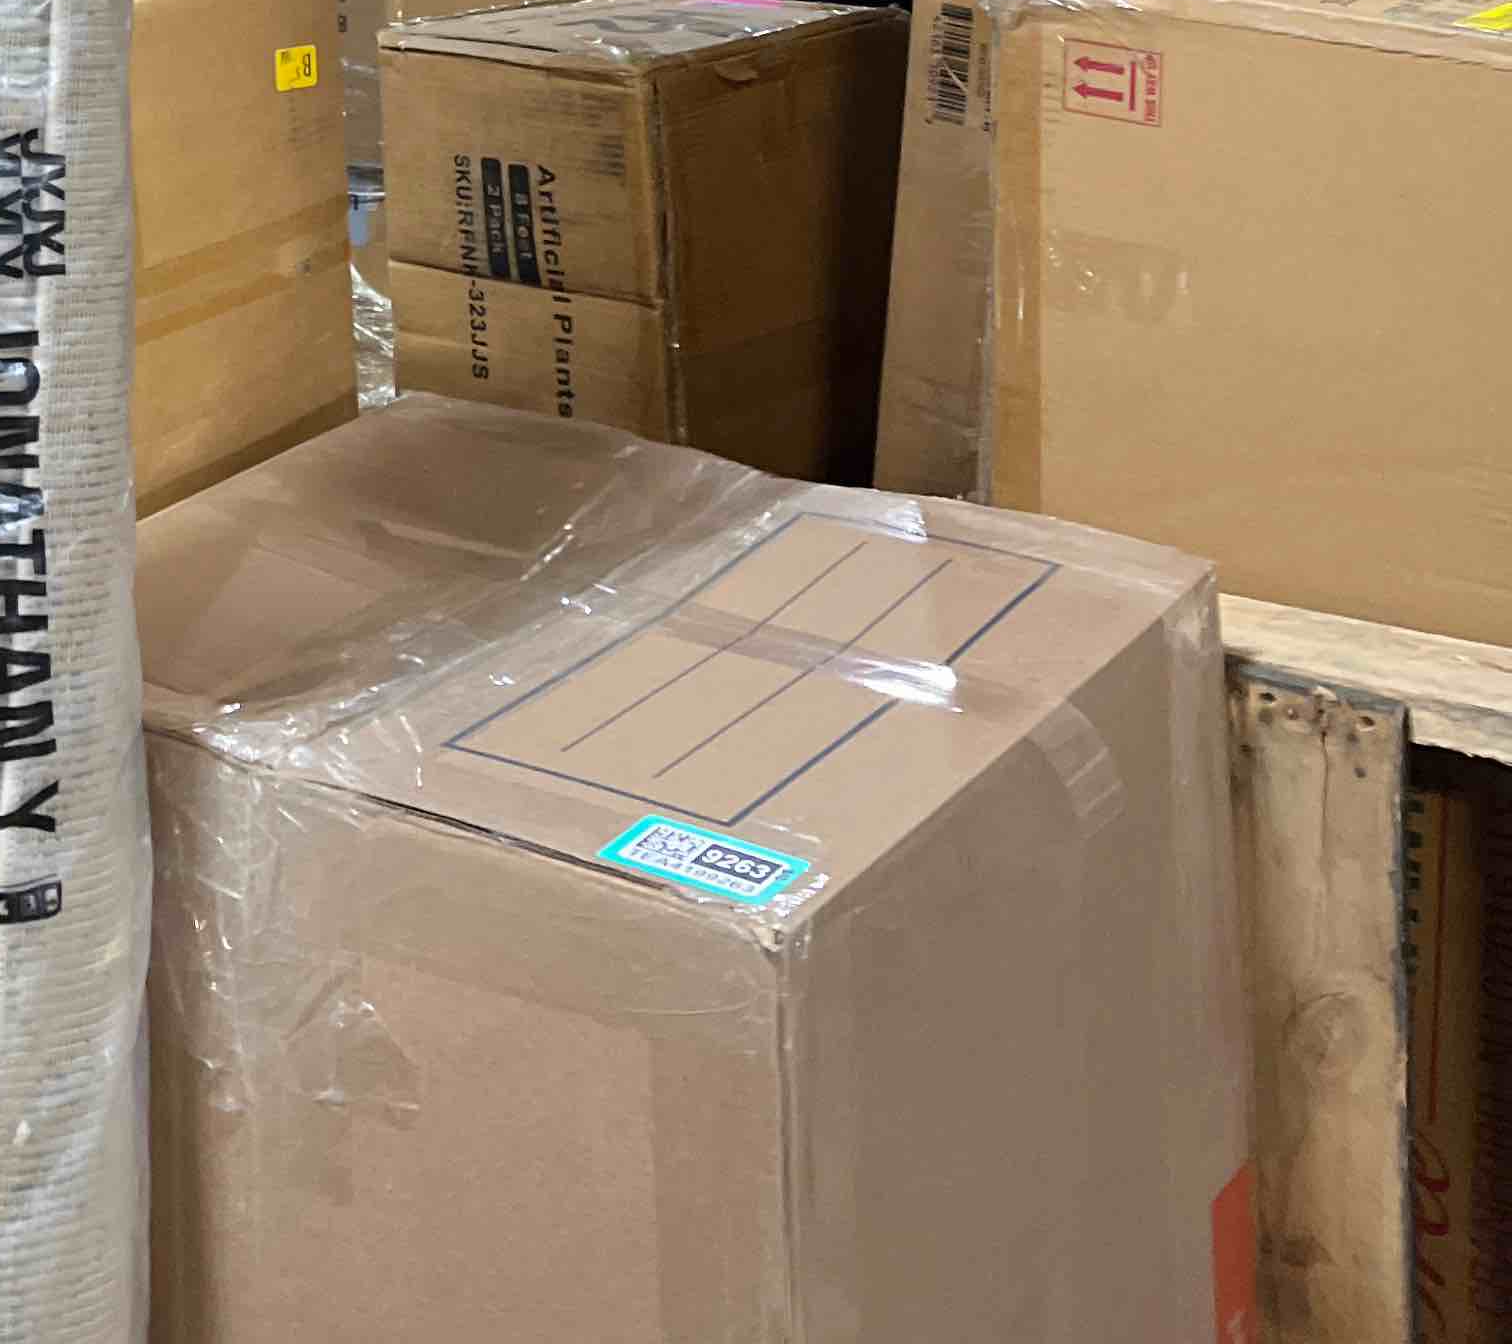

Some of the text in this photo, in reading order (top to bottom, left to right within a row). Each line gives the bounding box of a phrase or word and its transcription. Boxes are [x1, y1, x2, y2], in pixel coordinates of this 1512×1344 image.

[536, 163, 576, 419] Artificial Plants
[700, 848, 773, 880] 9263
